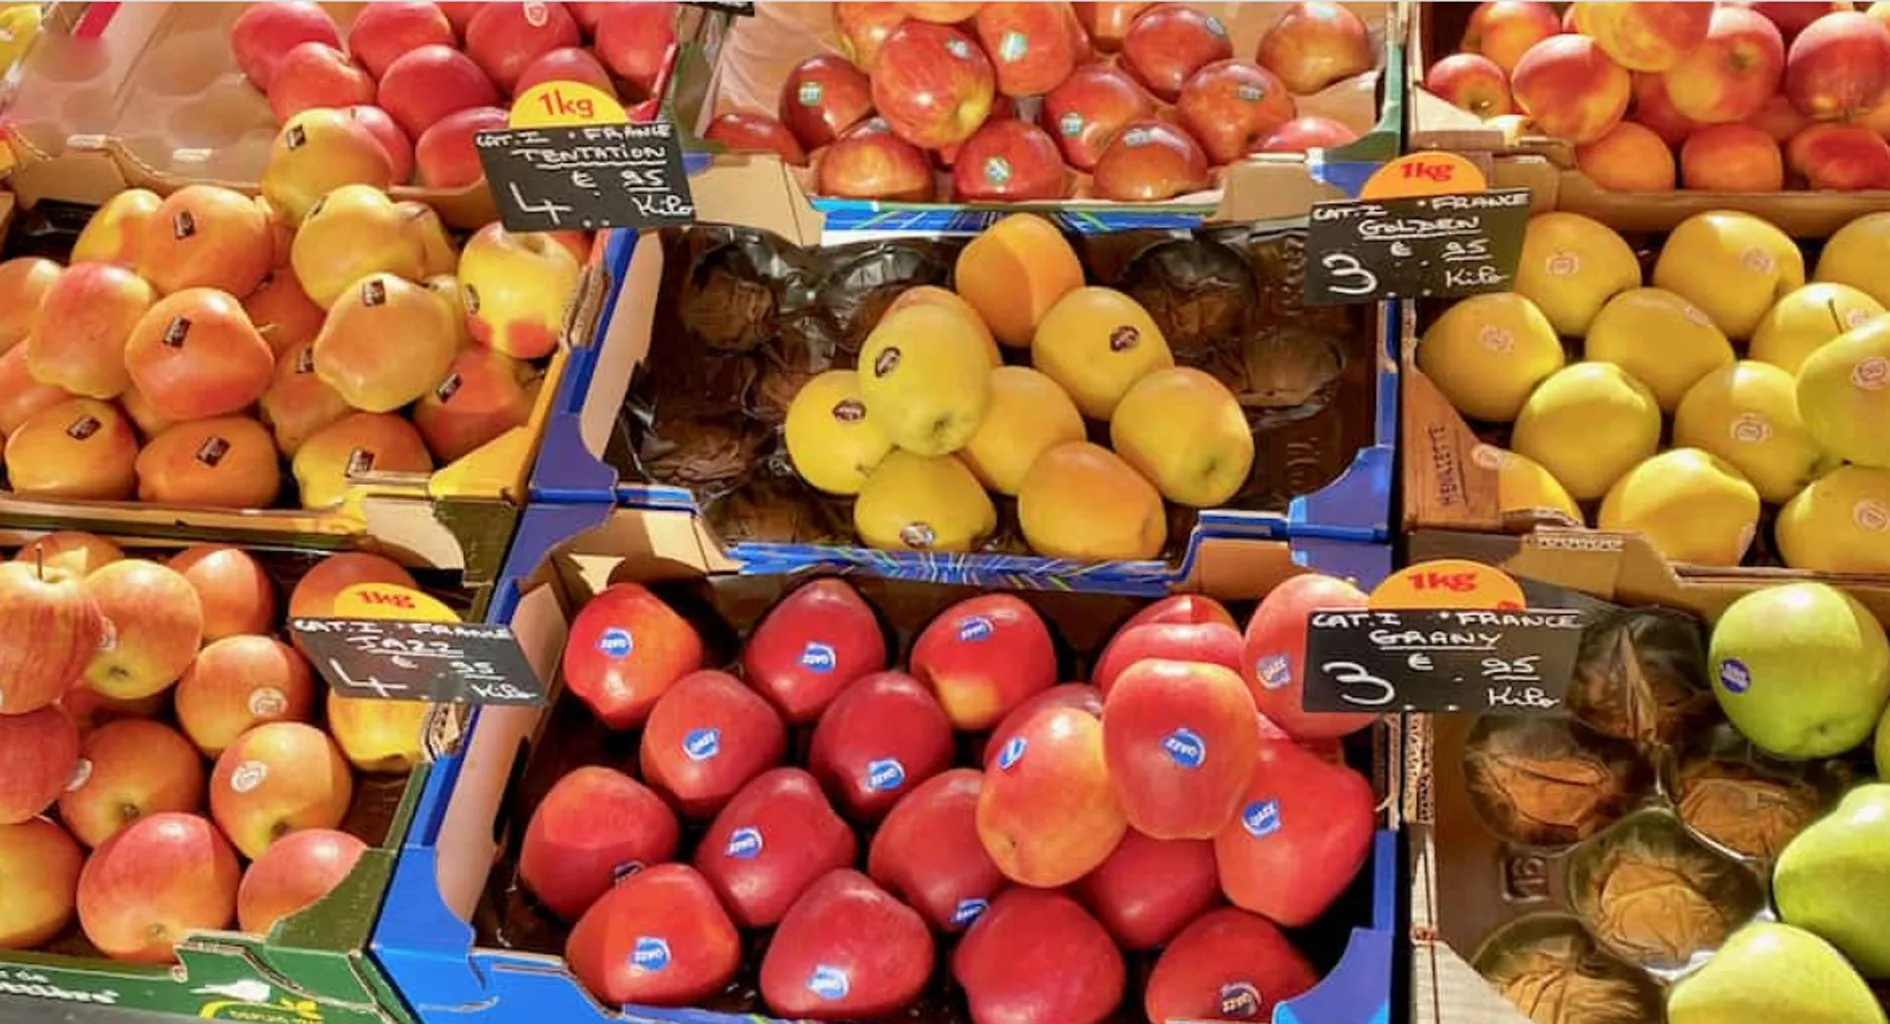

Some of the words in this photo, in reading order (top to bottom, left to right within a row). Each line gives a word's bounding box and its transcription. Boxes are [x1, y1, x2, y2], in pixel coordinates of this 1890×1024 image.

[538, 89, 593, 118] 1kg
[583, 123, 671, 140] FRANCE
[622, 169, 664, 187] 95
[1401, 163, 1455, 181] 1kg
[509, 182, 572, 225] 4
[1432, 193, 1530, 210] FRANCE
[1443, 238, 1490, 258] 95
[1322, 253, 1377, 294] 3
[1445, 266, 1511, 287] Kilo
[1408, 572, 1478, 592] 1kg
[356, 590, 416, 609] 1kg
[1456, 613, 1583, 629] FRANCE
[346, 636, 450, 652] JAZZ
[1369, 630, 1503, 646] GRANY
[1408, 653, 1434, 671] €
[1482, 655, 1540, 676] 95
[329, 659, 407, 697] 4
[1322, 662, 1395, 705] 3
[1488, 687, 1559, 708] Kilo
